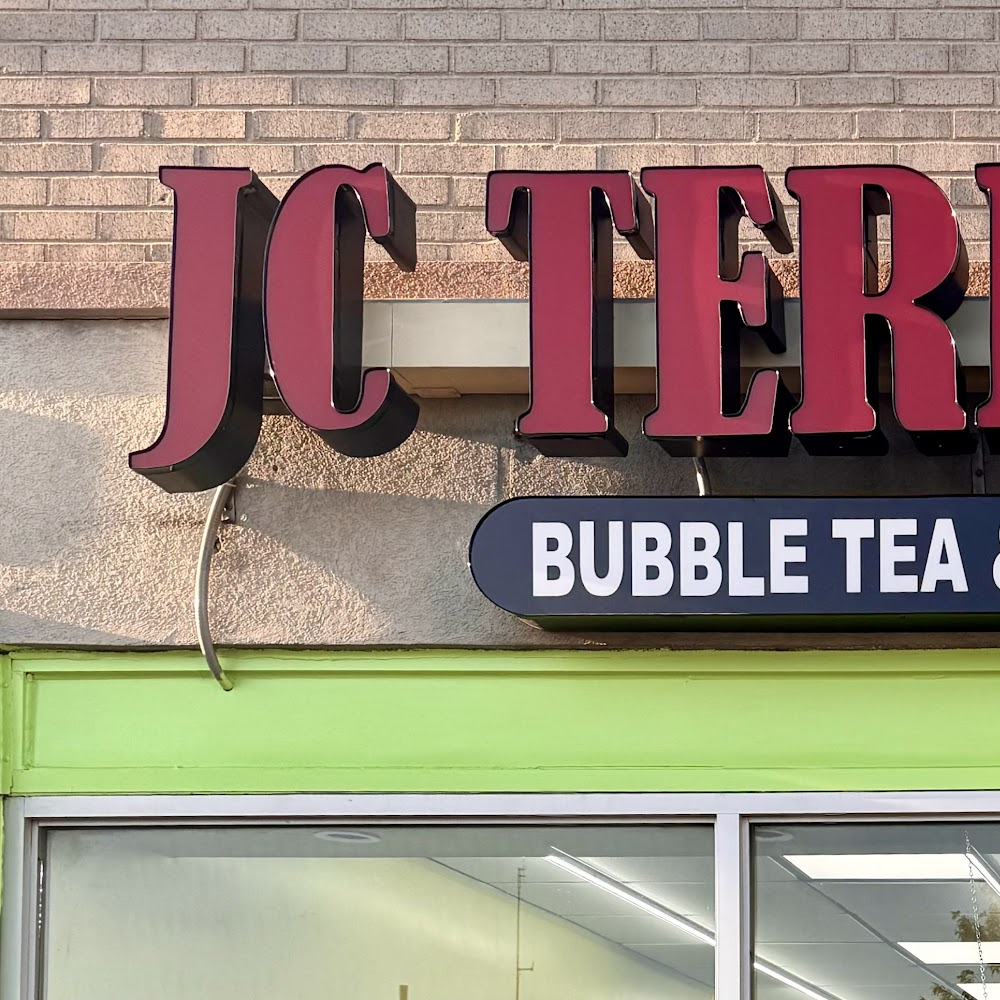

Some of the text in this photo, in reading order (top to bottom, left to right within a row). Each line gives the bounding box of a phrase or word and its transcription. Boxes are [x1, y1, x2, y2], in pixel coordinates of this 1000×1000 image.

[128, 163, 396, 472] JC
[531, 520, 809, 598] BUBBLE
[832, 518, 969, 594] TEA
